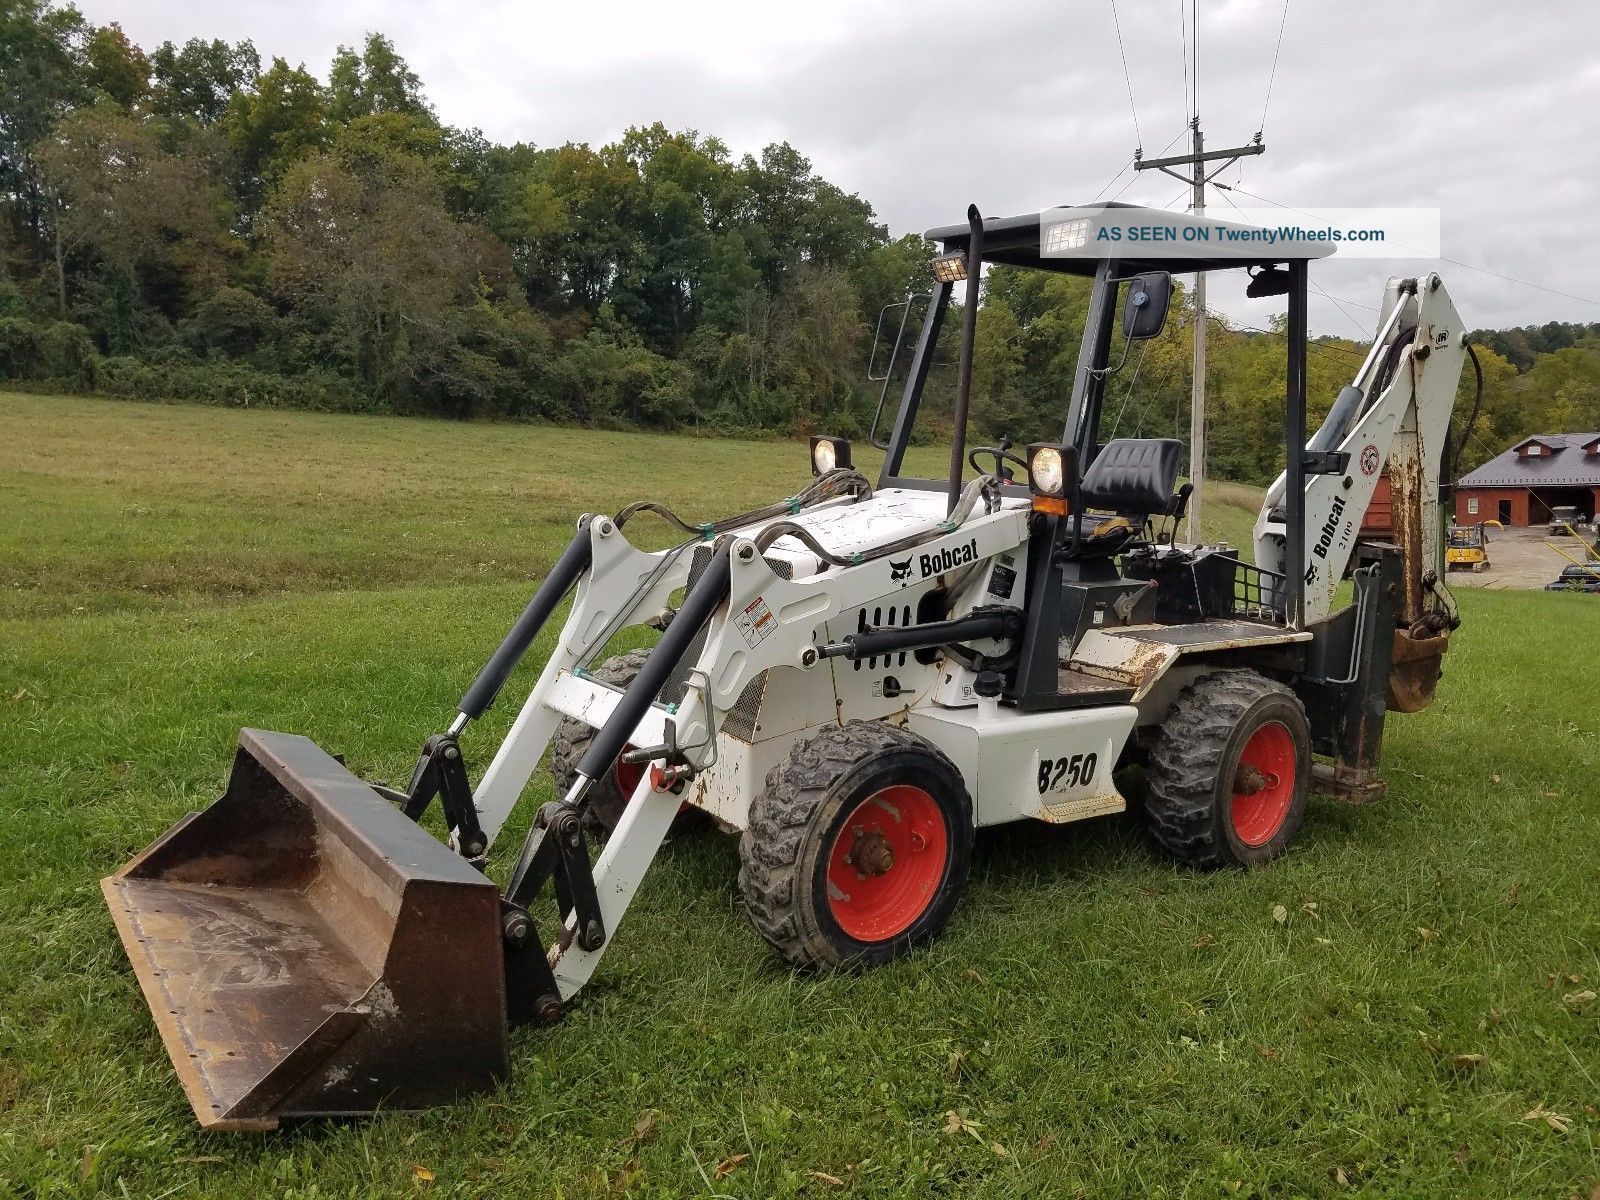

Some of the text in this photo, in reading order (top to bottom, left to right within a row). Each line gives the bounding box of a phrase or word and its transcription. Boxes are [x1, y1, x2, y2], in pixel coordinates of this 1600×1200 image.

[1312, 494, 1346, 559] Bobcat
[919, 537, 979, 578] Bobcat
[1038, 752, 1098, 794] B250
